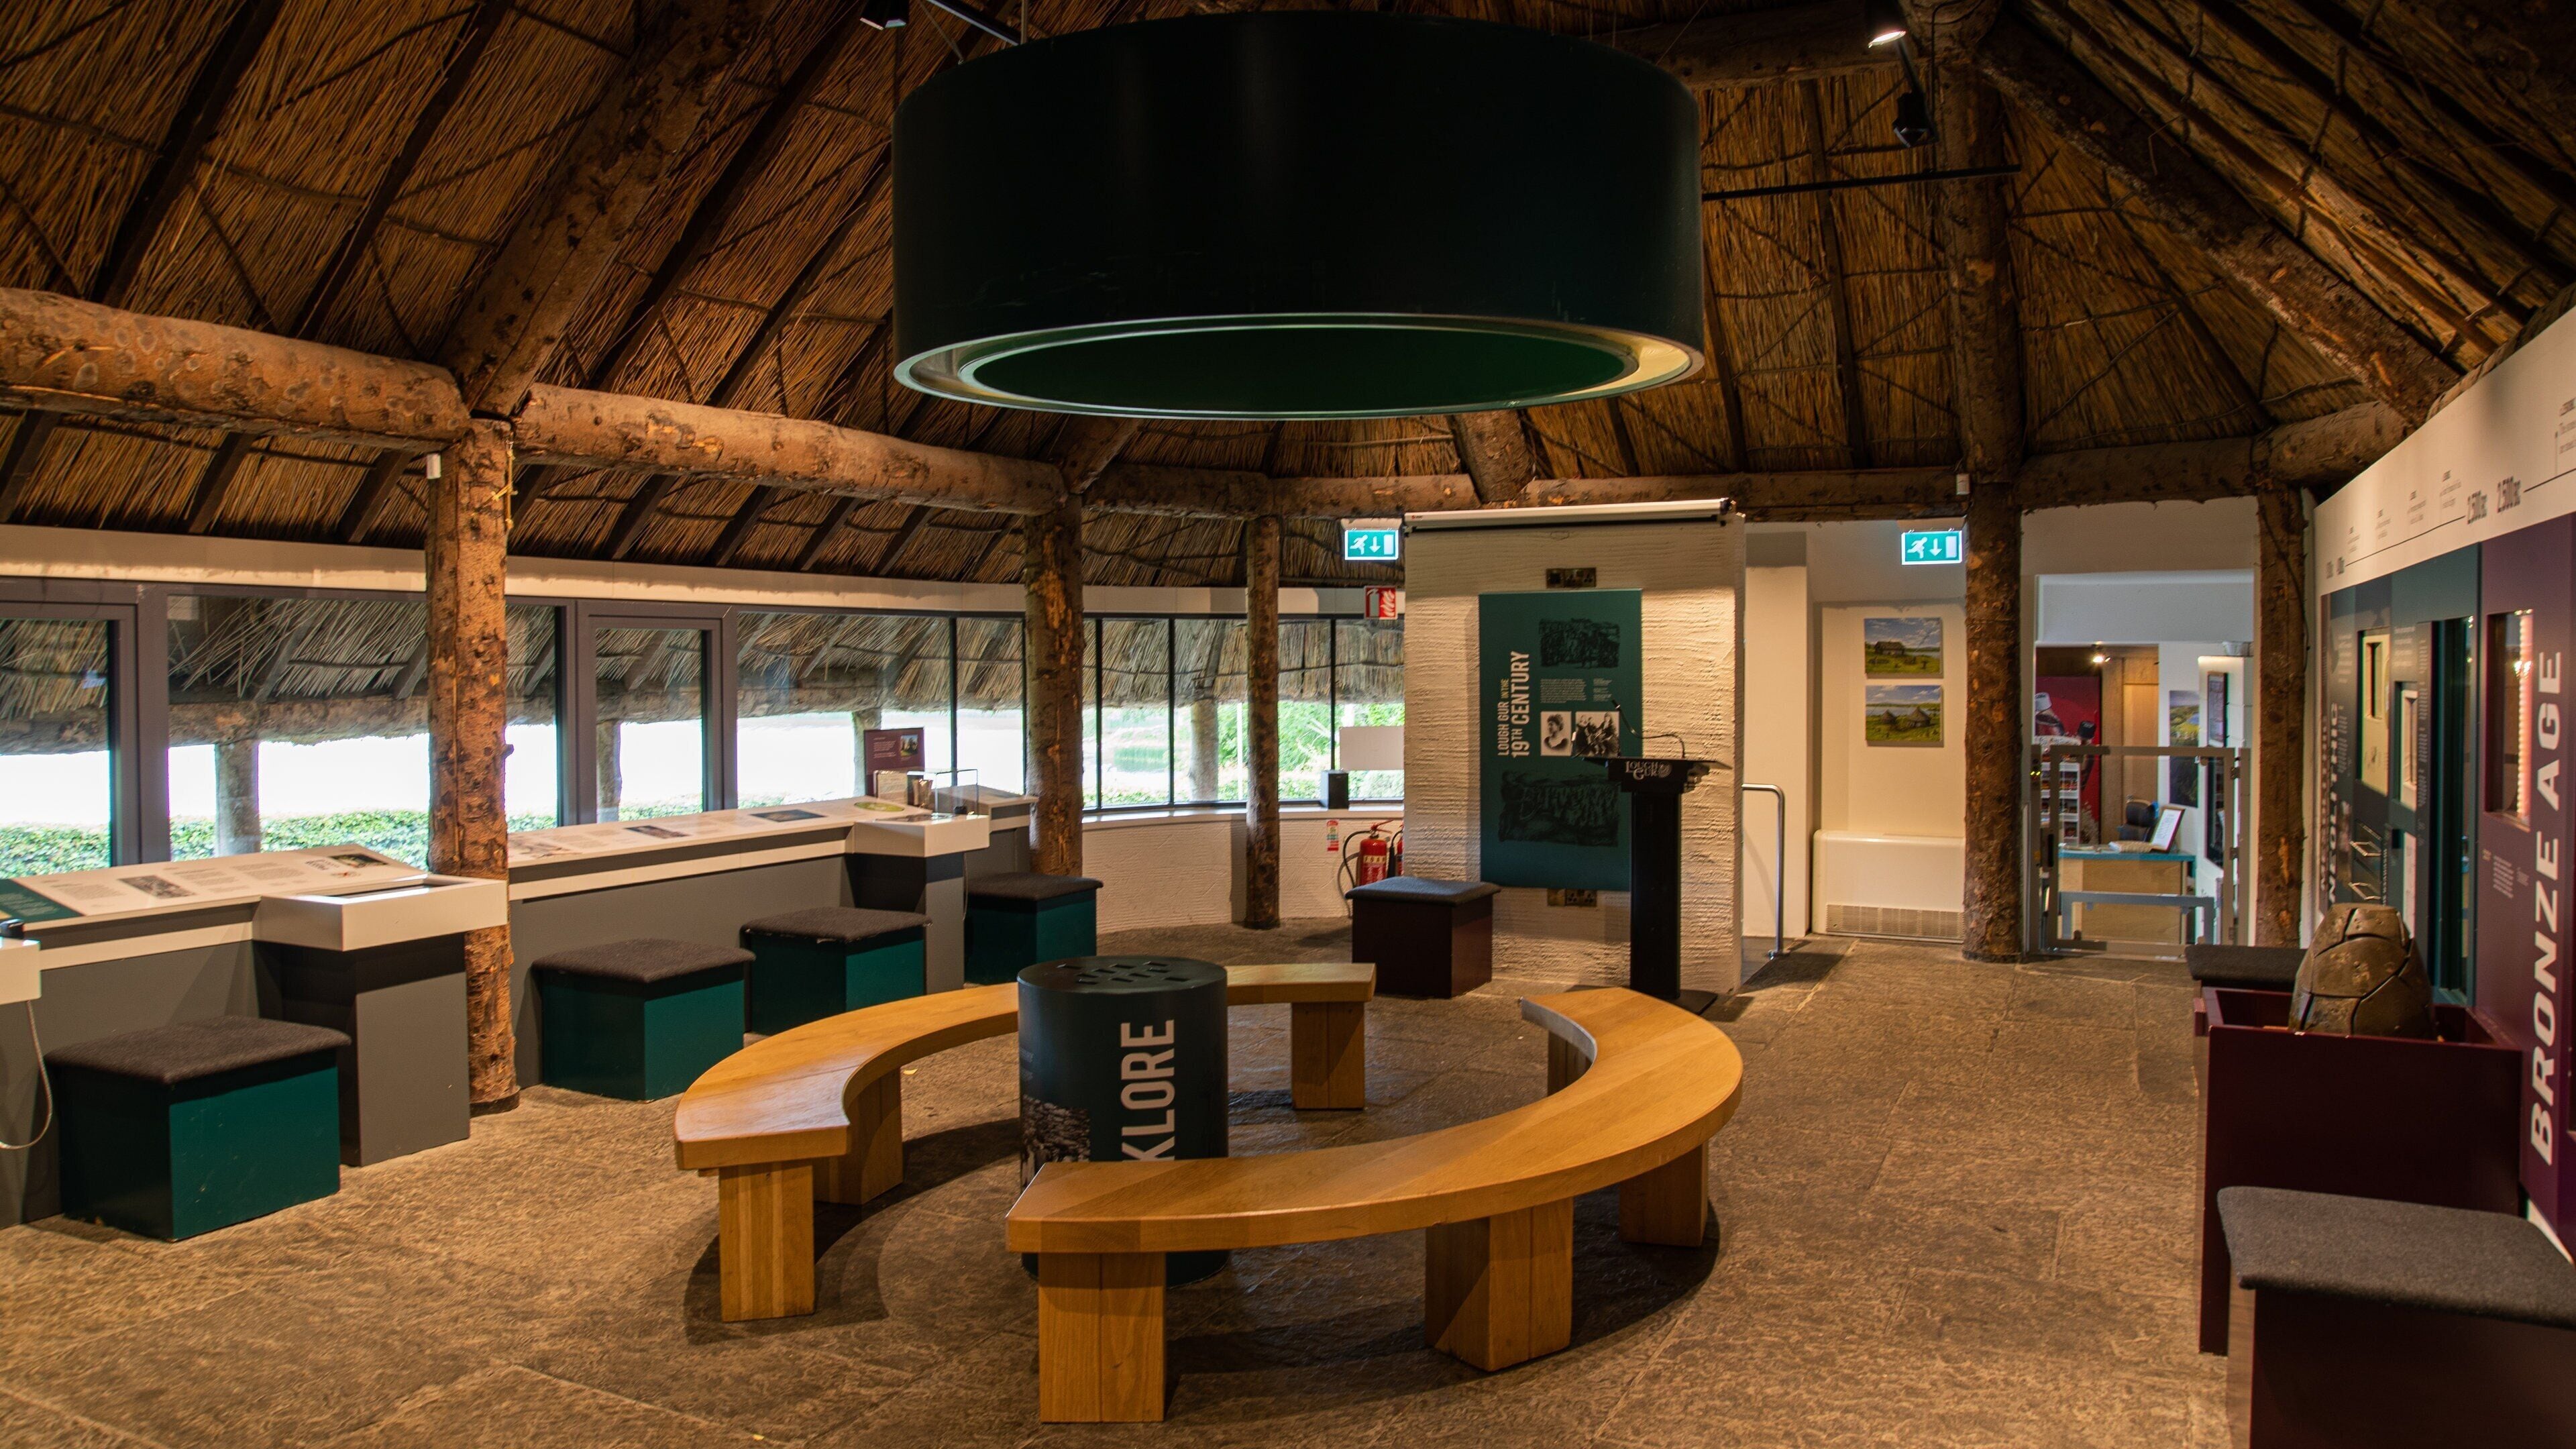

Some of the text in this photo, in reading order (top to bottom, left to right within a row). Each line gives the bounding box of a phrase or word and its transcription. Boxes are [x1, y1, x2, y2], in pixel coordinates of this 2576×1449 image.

[1497, 701, 1509, 722] GUR
[1511, 651, 1529, 758] 19TH CENTURY
[1497, 724, 1509, 756] LOUGH
[2530, 652, 2561, 1166] BRONZE AGE
